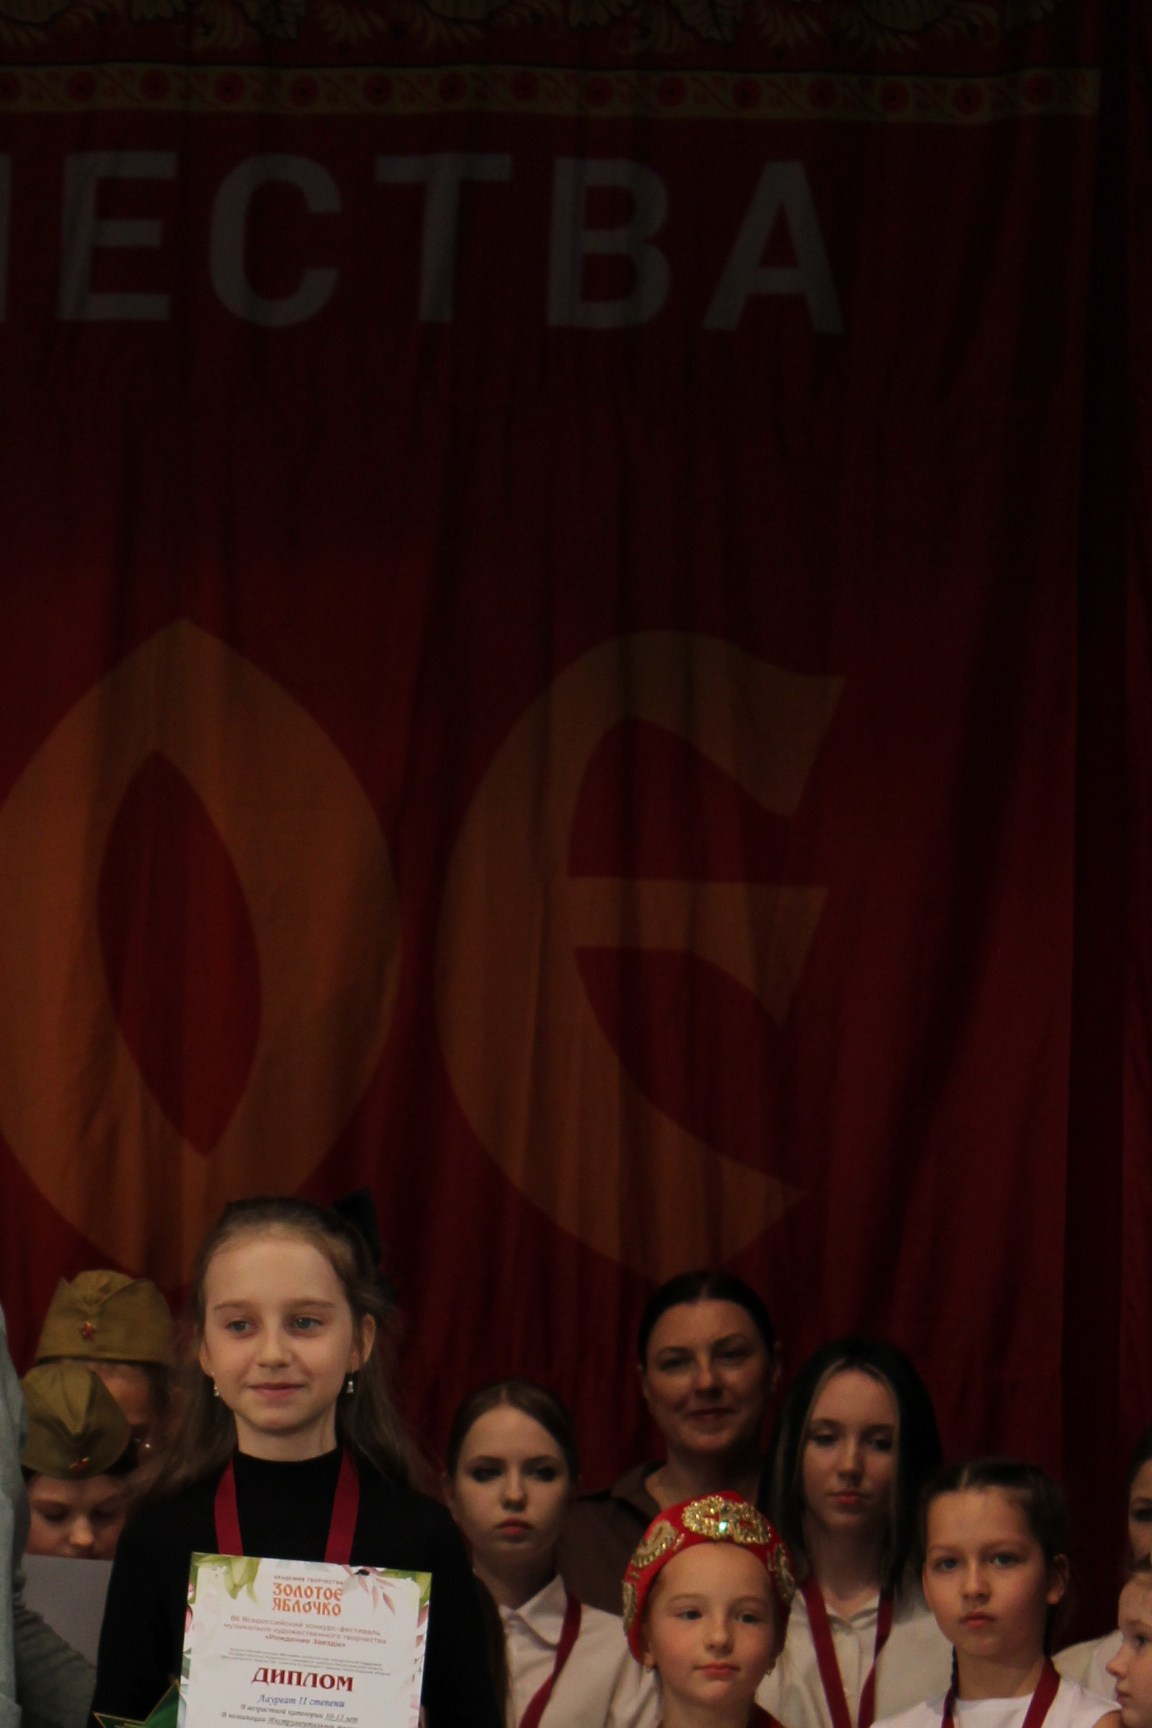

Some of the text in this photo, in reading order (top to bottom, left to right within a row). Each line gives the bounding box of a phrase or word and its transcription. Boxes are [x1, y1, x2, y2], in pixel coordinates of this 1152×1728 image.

[307, 1577, 344, 1586] ТВОРЧЕСТВА
[272, 1582, 344, 1601] ЗОЛОТОЕ
[272, 1597, 342, 1617] ЯБЛОЧКО
[242, 1616, 304, 1628] Всероссийский
[343, 1634, 387, 1645] творчества
[251, 1667, 354, 1692] ДИПЛОМ
[258, 1694, 296, 1706] Лауреат
[309, 1698, 345, 1708] степени
[228, 1713, 266, 1723] номинации
[246, 1705, 287, 1715] возрастной
[288, 1709, 324, 1720] категории
